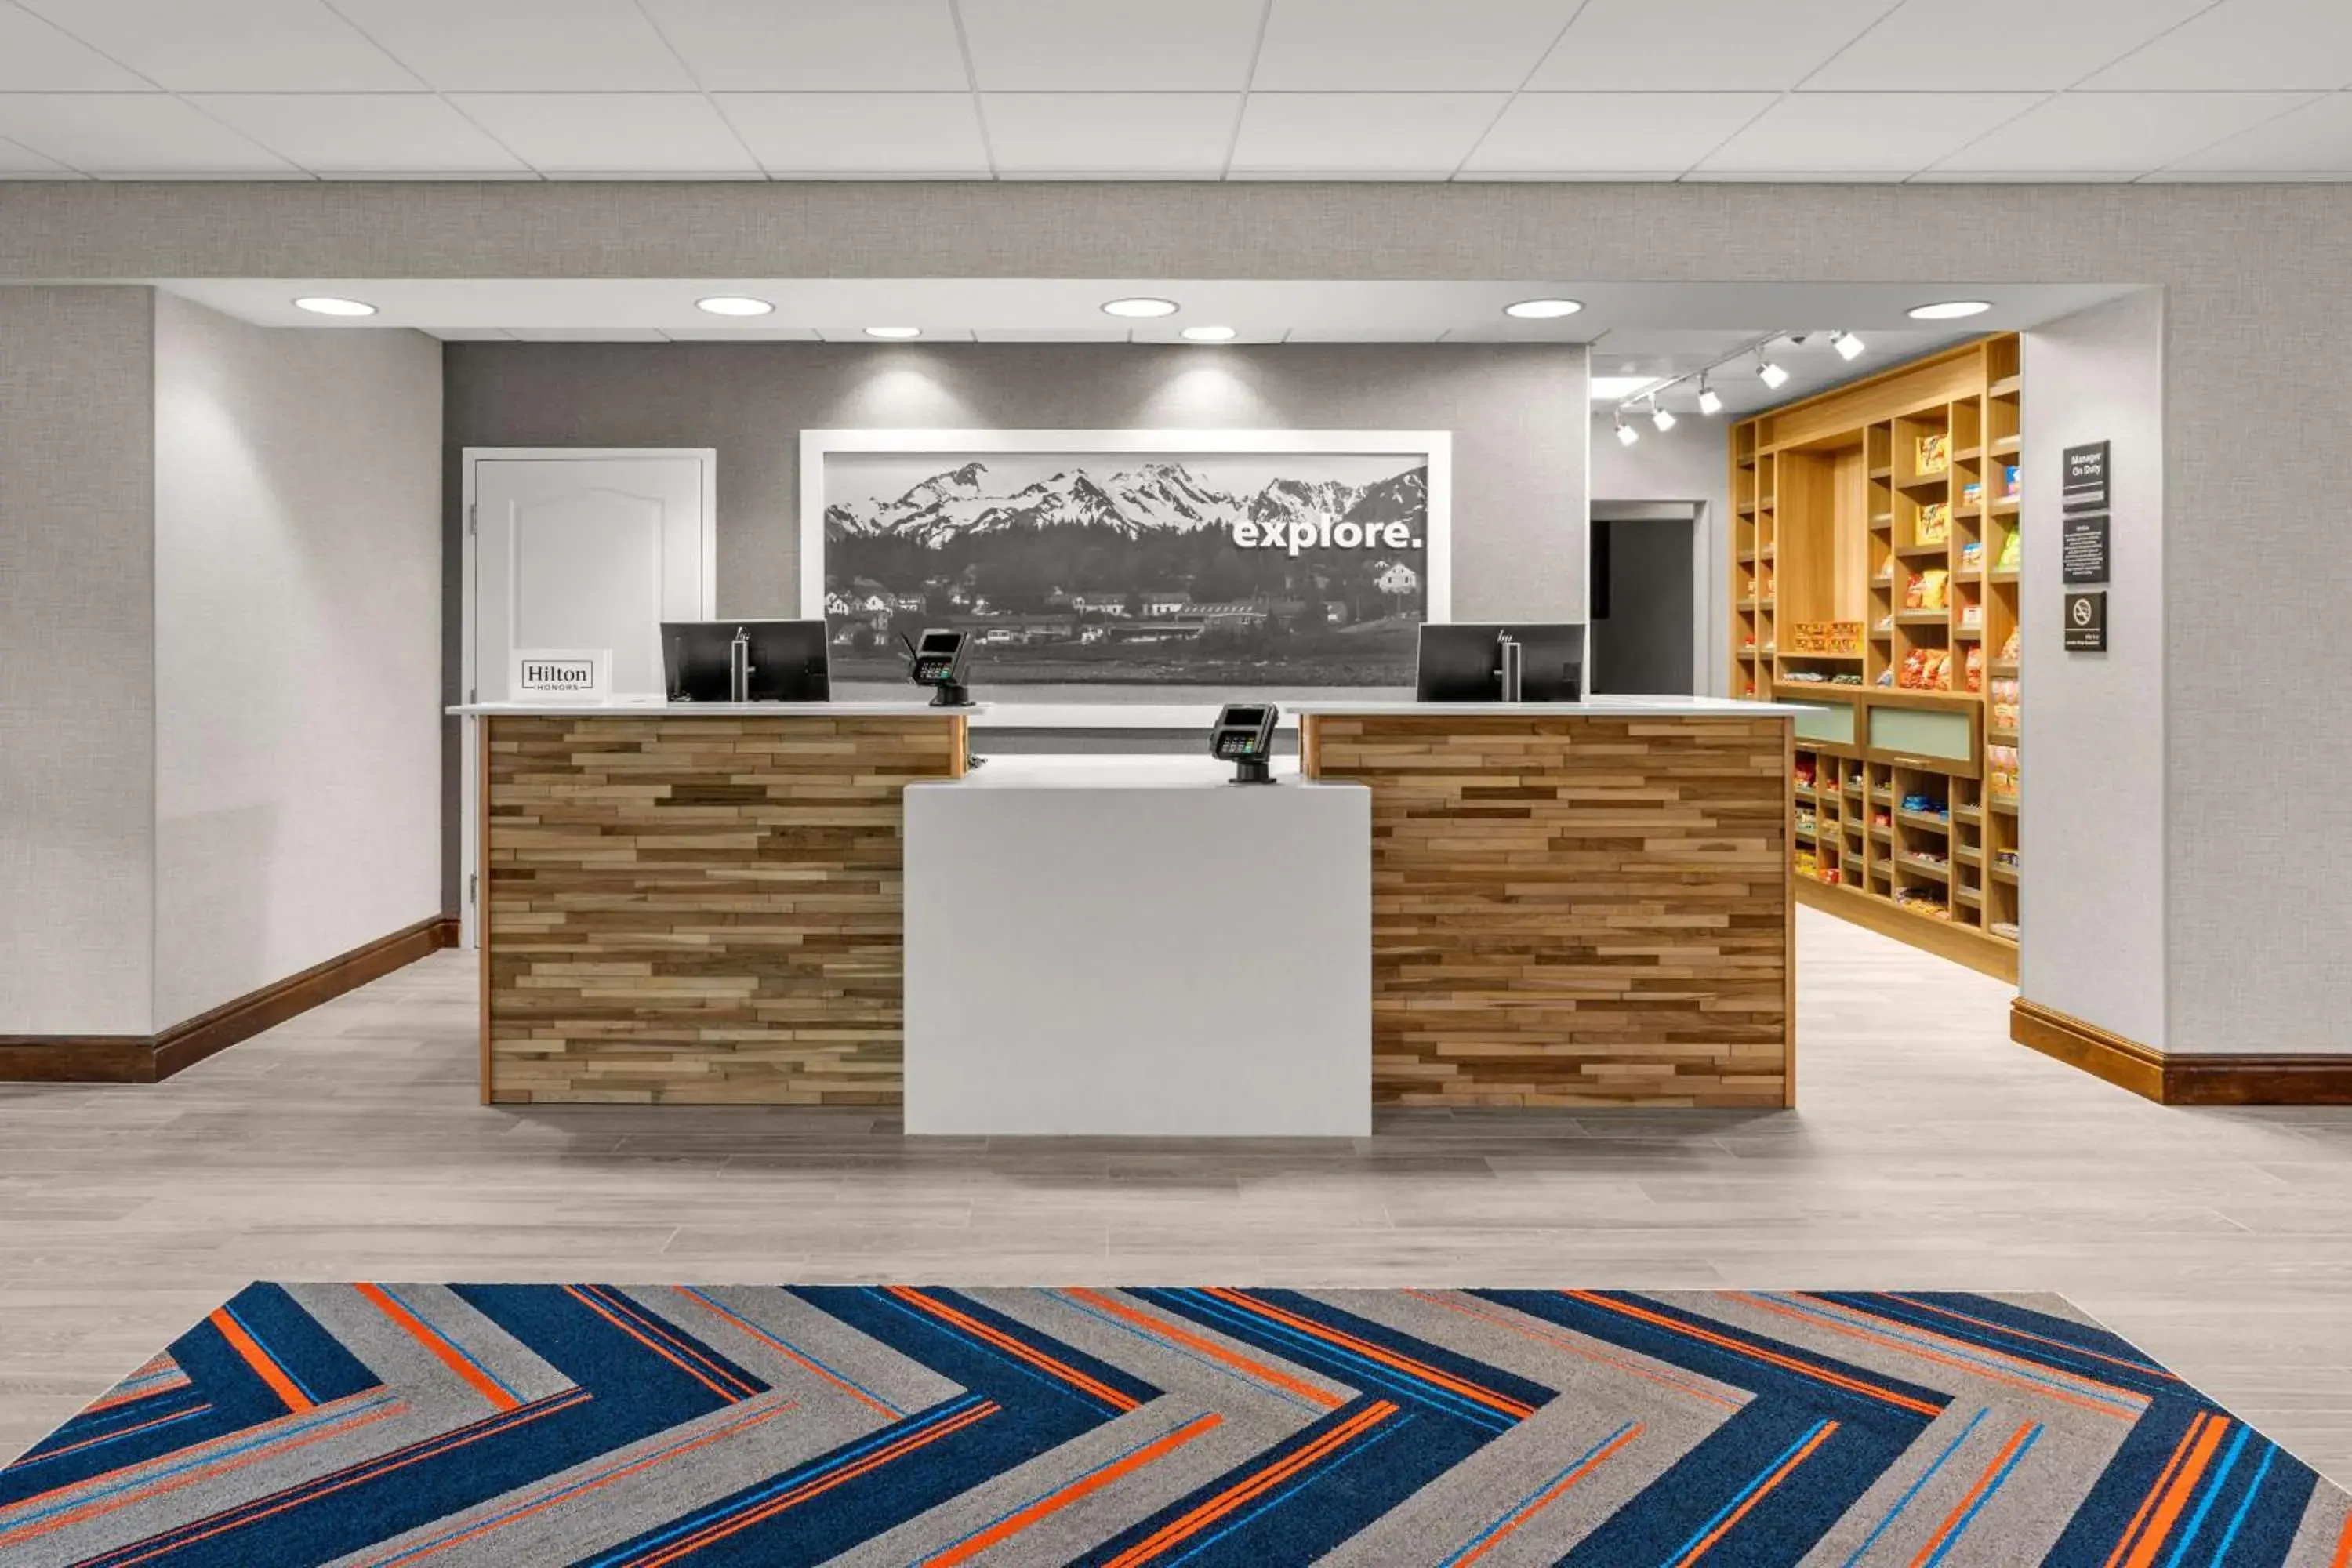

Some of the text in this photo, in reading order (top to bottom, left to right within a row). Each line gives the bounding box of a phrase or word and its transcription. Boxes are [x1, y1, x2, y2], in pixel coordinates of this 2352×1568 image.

[2071, 453, 2101, 464] Manager
[2072, 465, 2100, 476] On Duty
[1232, 512, 1422, 556] explore.
[529, 666, 586, 681] Hilton
